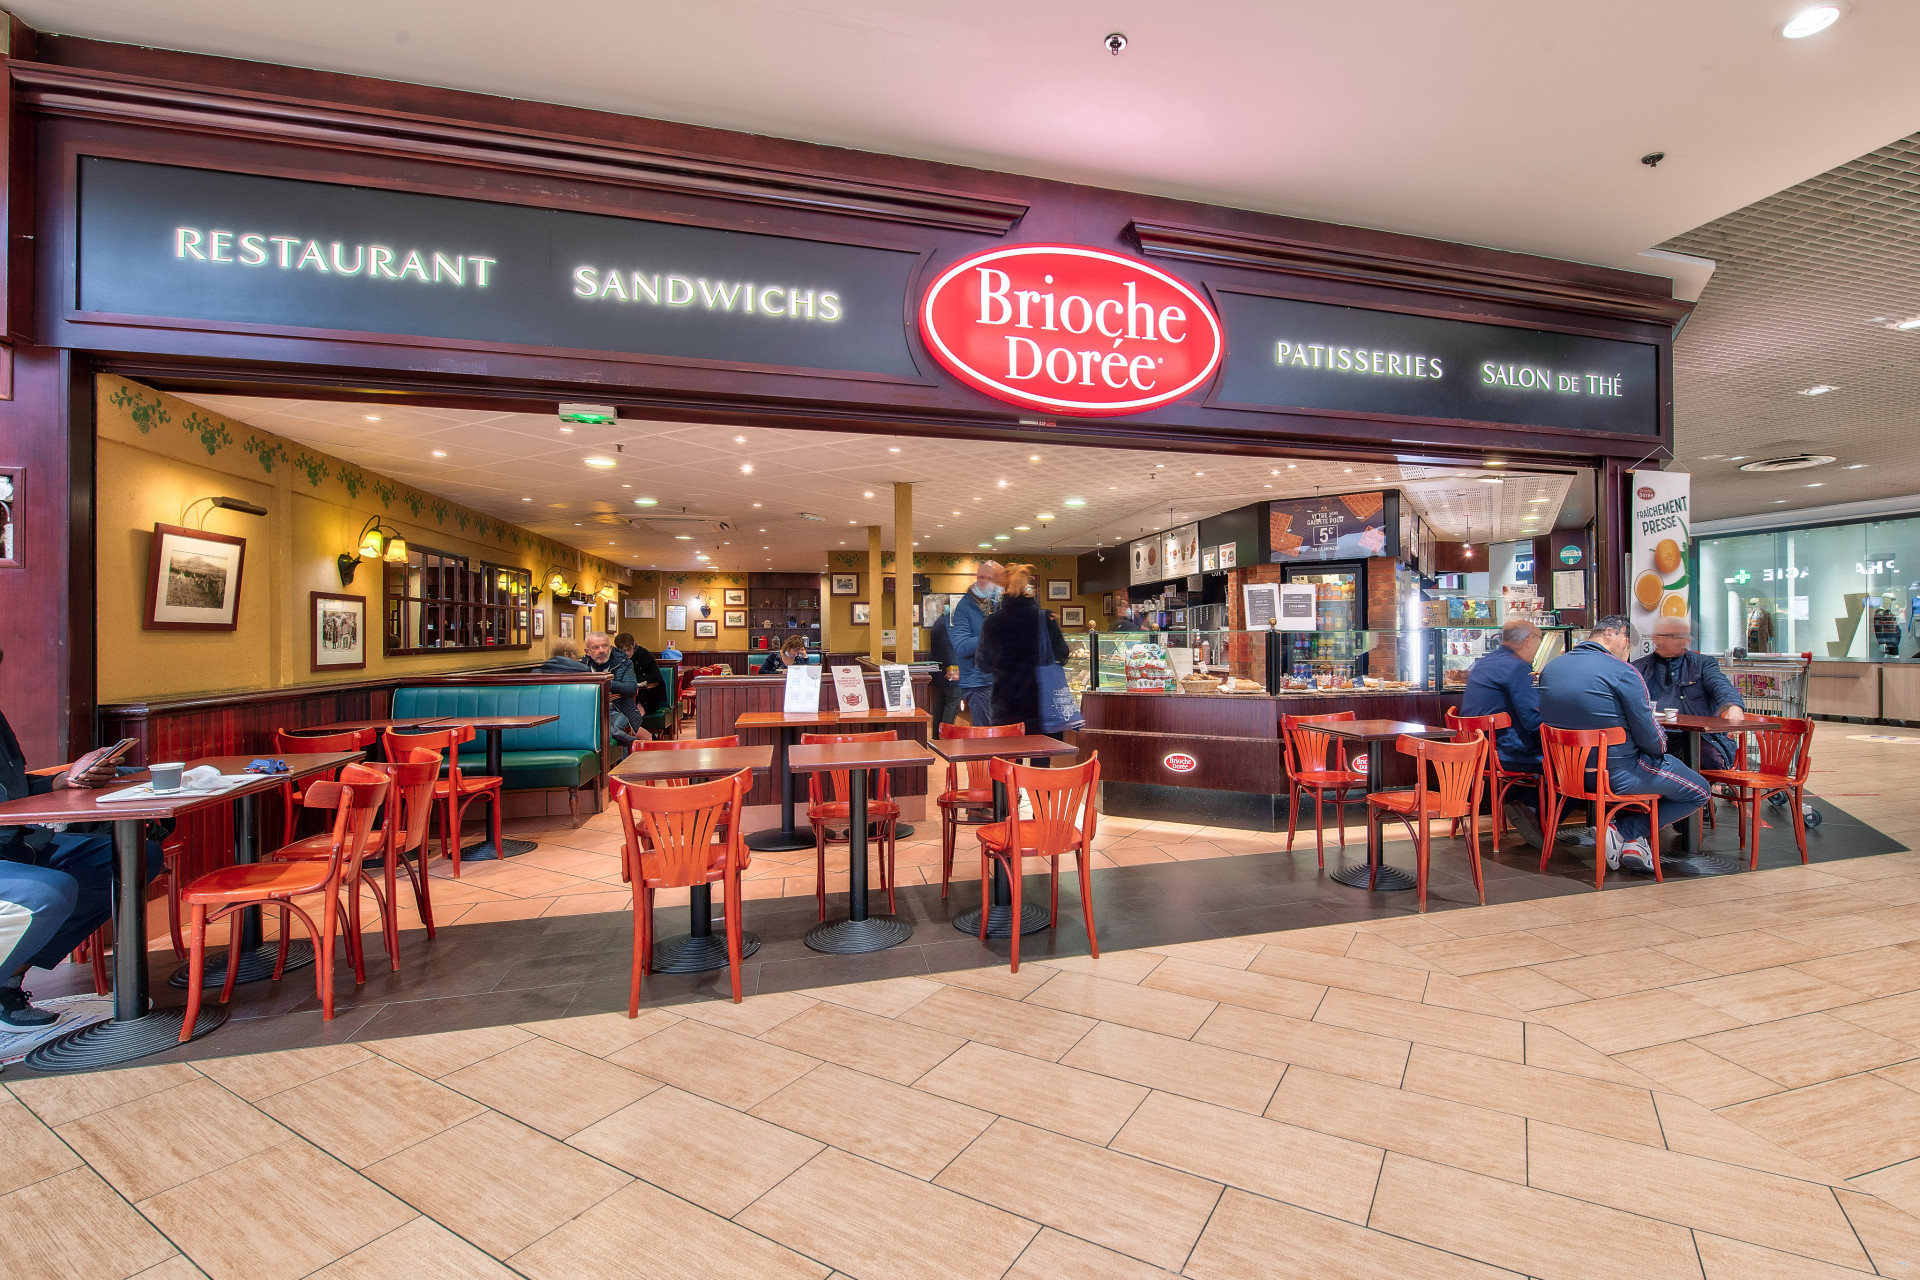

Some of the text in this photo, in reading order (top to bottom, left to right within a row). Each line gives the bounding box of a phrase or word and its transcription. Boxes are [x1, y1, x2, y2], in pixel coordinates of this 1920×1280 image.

[174, 226, 497, 288] RESTAURANT
[573, 266, 843, 322] SANDWICHS
[975, 266, 1188, 344] Brioche
[1004, 335, 1158, 391] Dorée
[1275, 340, 1444, 380] PATISSERIES
[1482, 362, 1624, 398] SALON DE THÉ
[1169, 756, 1192, 765] Brioche
